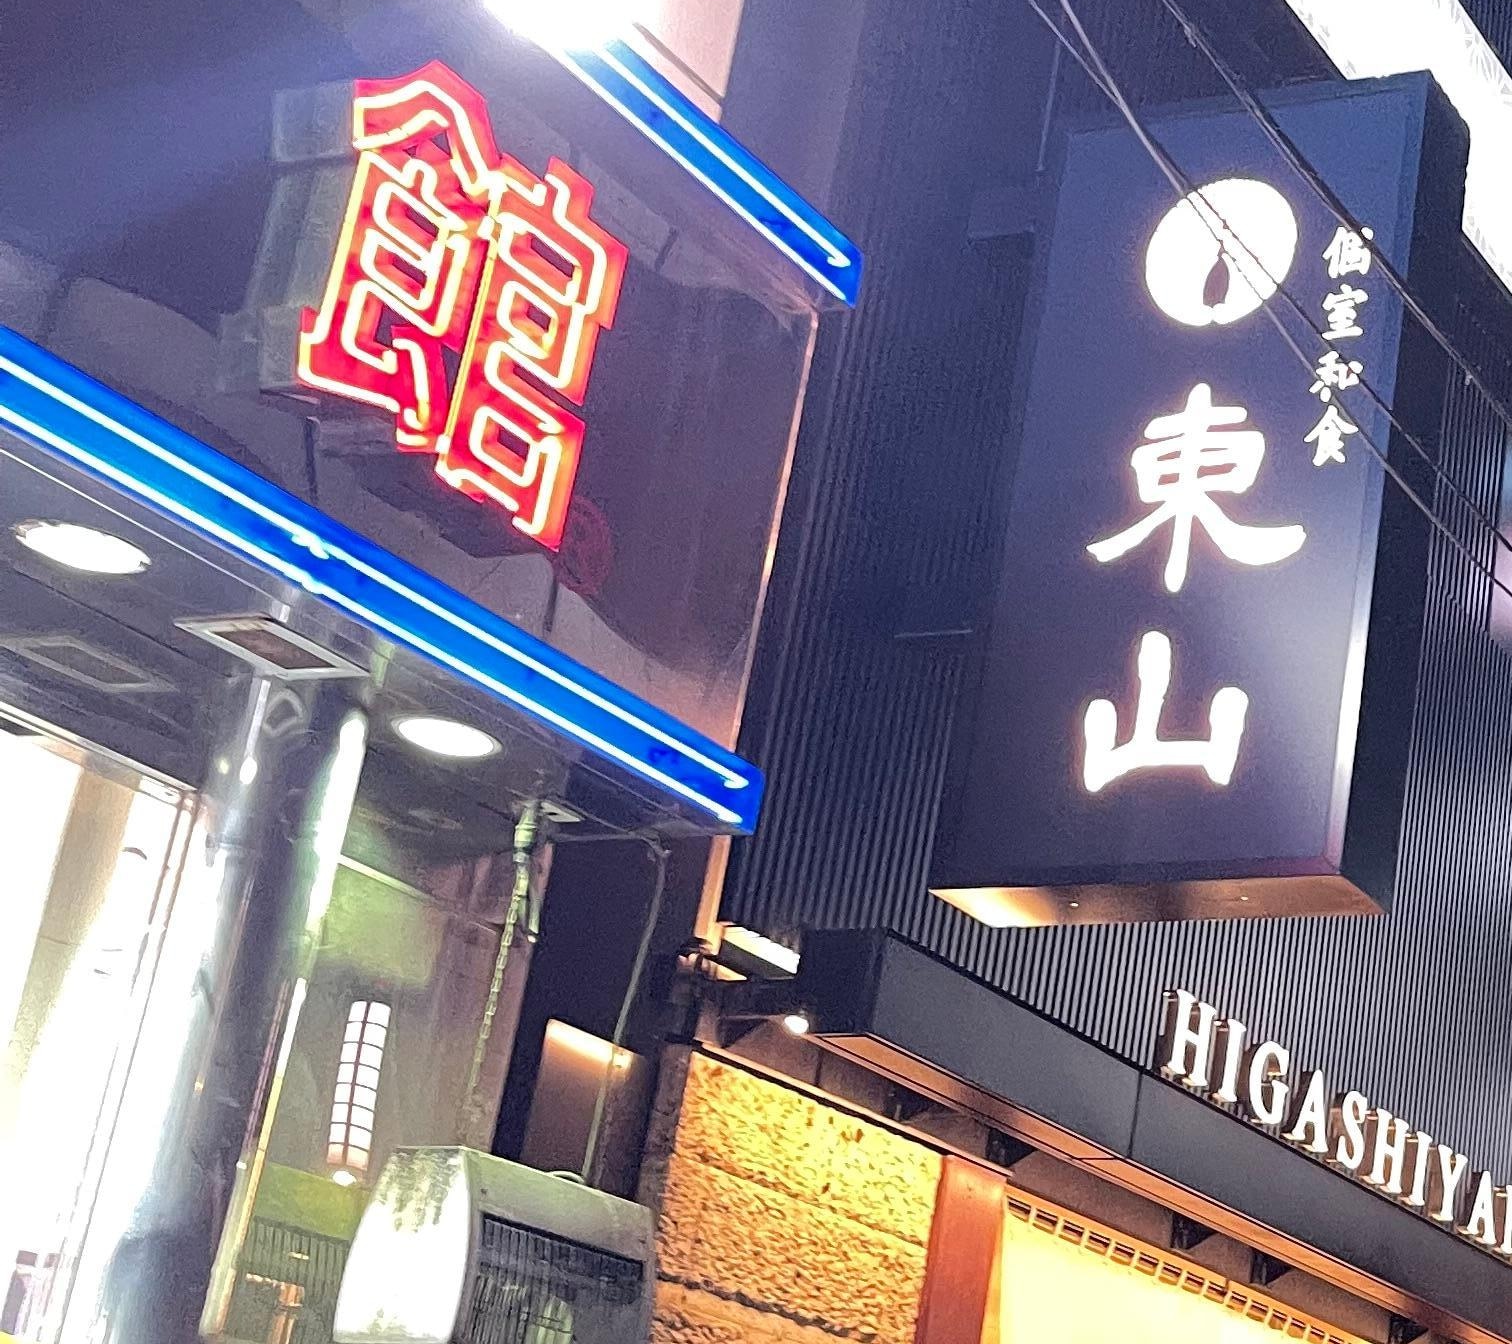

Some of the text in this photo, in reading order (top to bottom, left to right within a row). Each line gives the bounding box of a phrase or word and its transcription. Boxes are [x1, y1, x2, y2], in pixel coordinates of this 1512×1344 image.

[297, 59, 630, 552] 館
[1302, 225, 1374, 468] 個室和食
[1083, 381, 1307, 793] 東山
